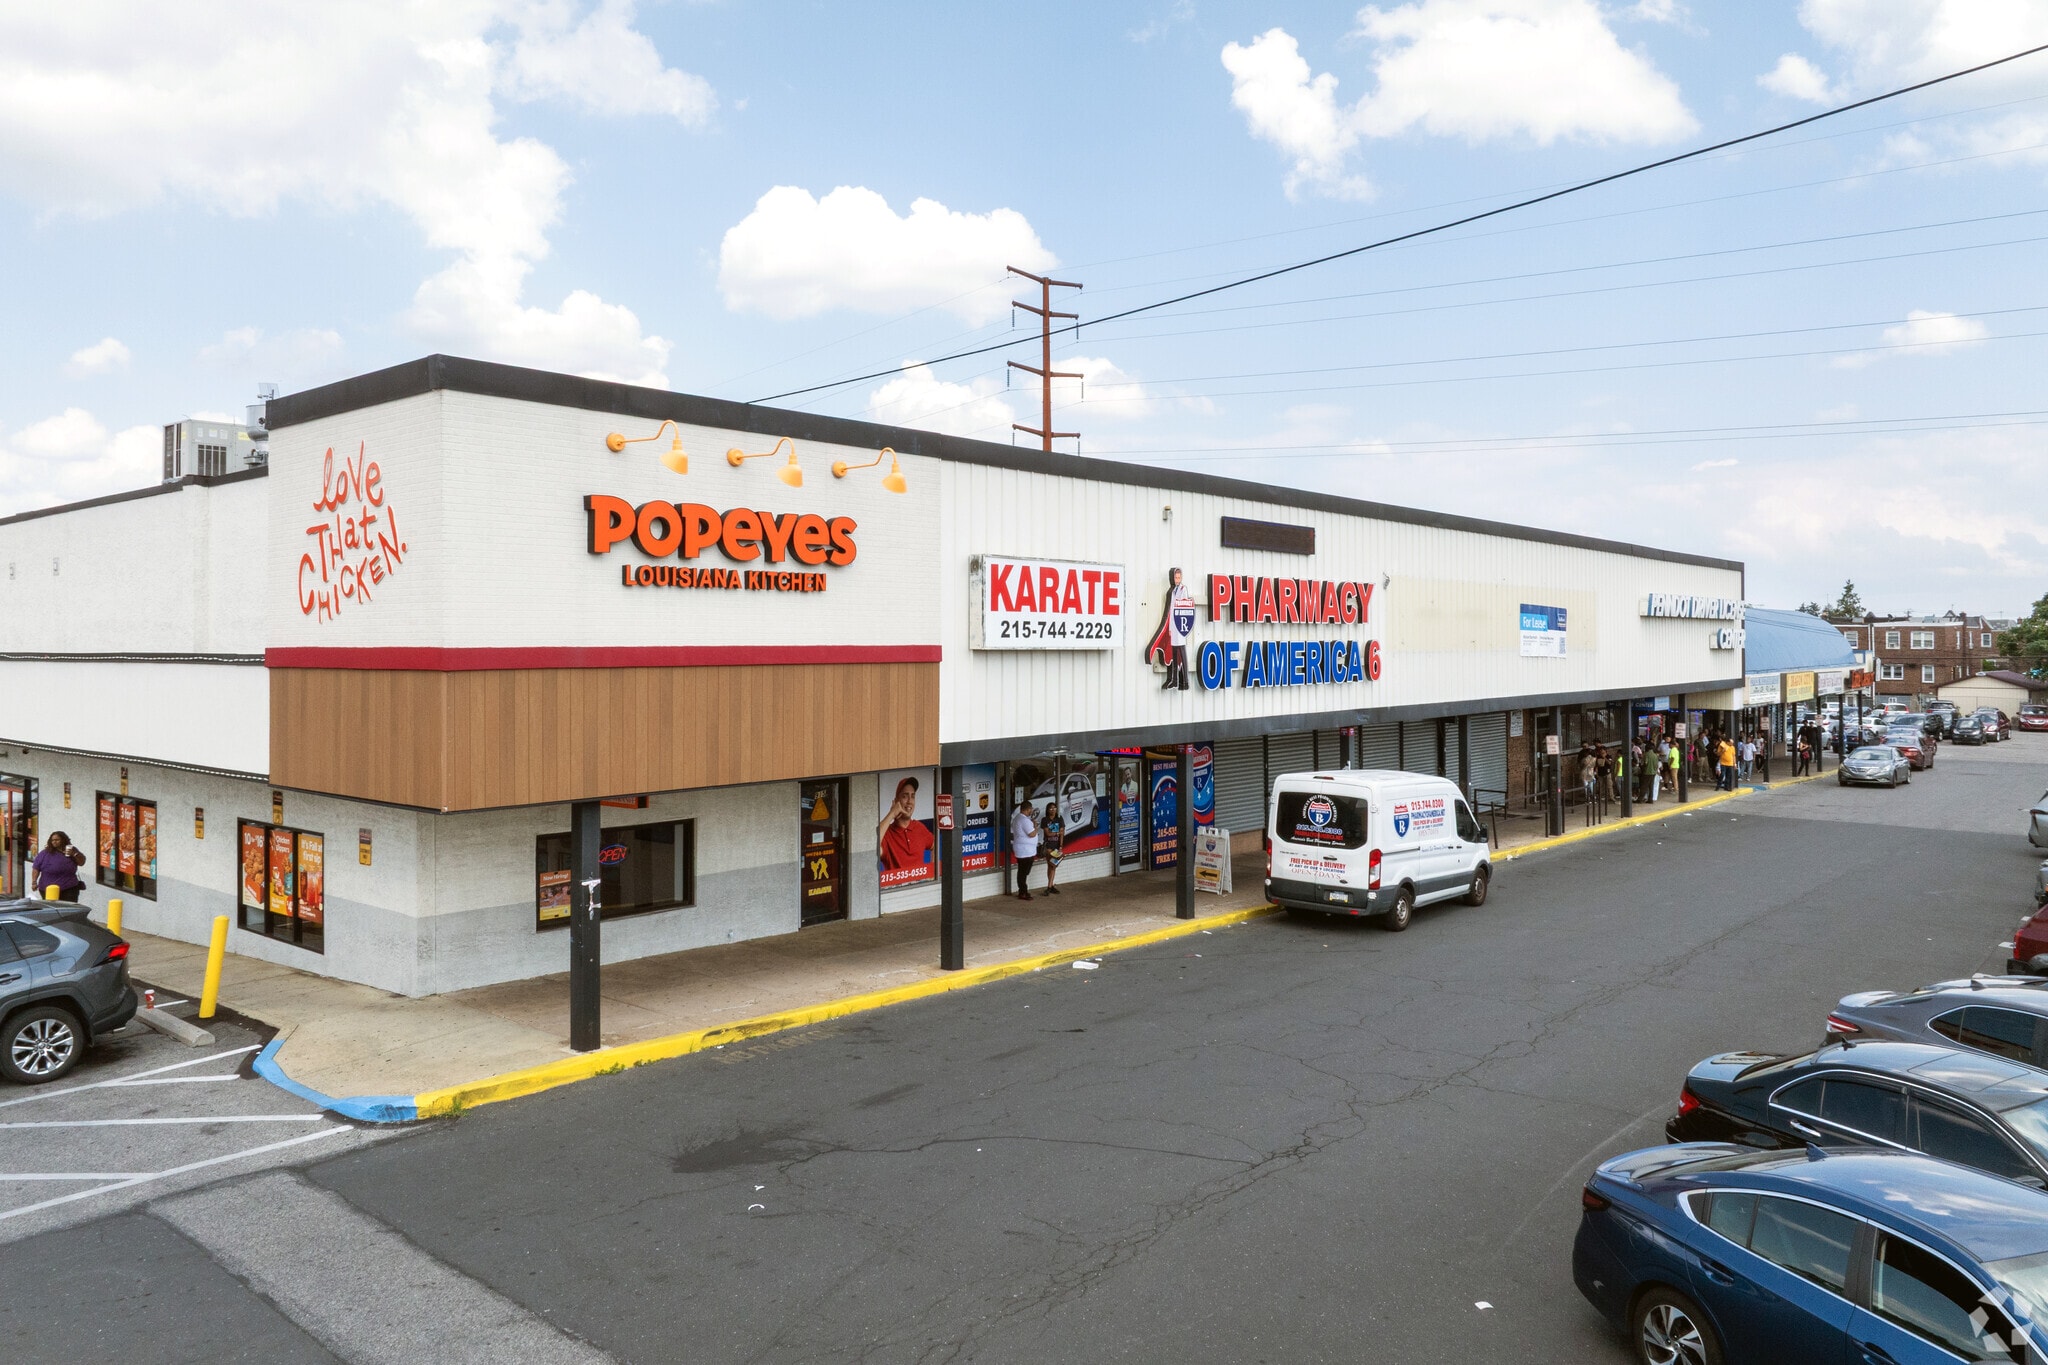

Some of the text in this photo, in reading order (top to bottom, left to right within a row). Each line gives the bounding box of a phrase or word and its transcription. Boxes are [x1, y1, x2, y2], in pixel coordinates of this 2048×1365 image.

[622, 564, 827, 592] LOUISIANA KITCHEN
[990, 563, 1120, 616] KARATE
[1207, 572, 1374, 625] PHARMACY
[1523, 616, 1532, 628] For
[1532, 617, 1546, 629] Lease
[1716, 628, 1746, 650] CENTER
[1197, 639, 1382, 691] OF AMERICA 6
[978, 782, 990, 790] ATM
[1411, 799, 1444, 811] 215.744.0300
[967, 817, 988, 826] ORDERS
[962, 832, 988, 843] PICK-UP
[598, 847, 627, 863] OPEN
[966, 857, 987, 868] 7 DAYS
[1324, 861, 1346, 870] DELIVERY
[881, 867, 928, 883] 215-535-0555
[1291, 868, 1311, 876] OPEN
[1318, 870, 1341, 880] DAYS
